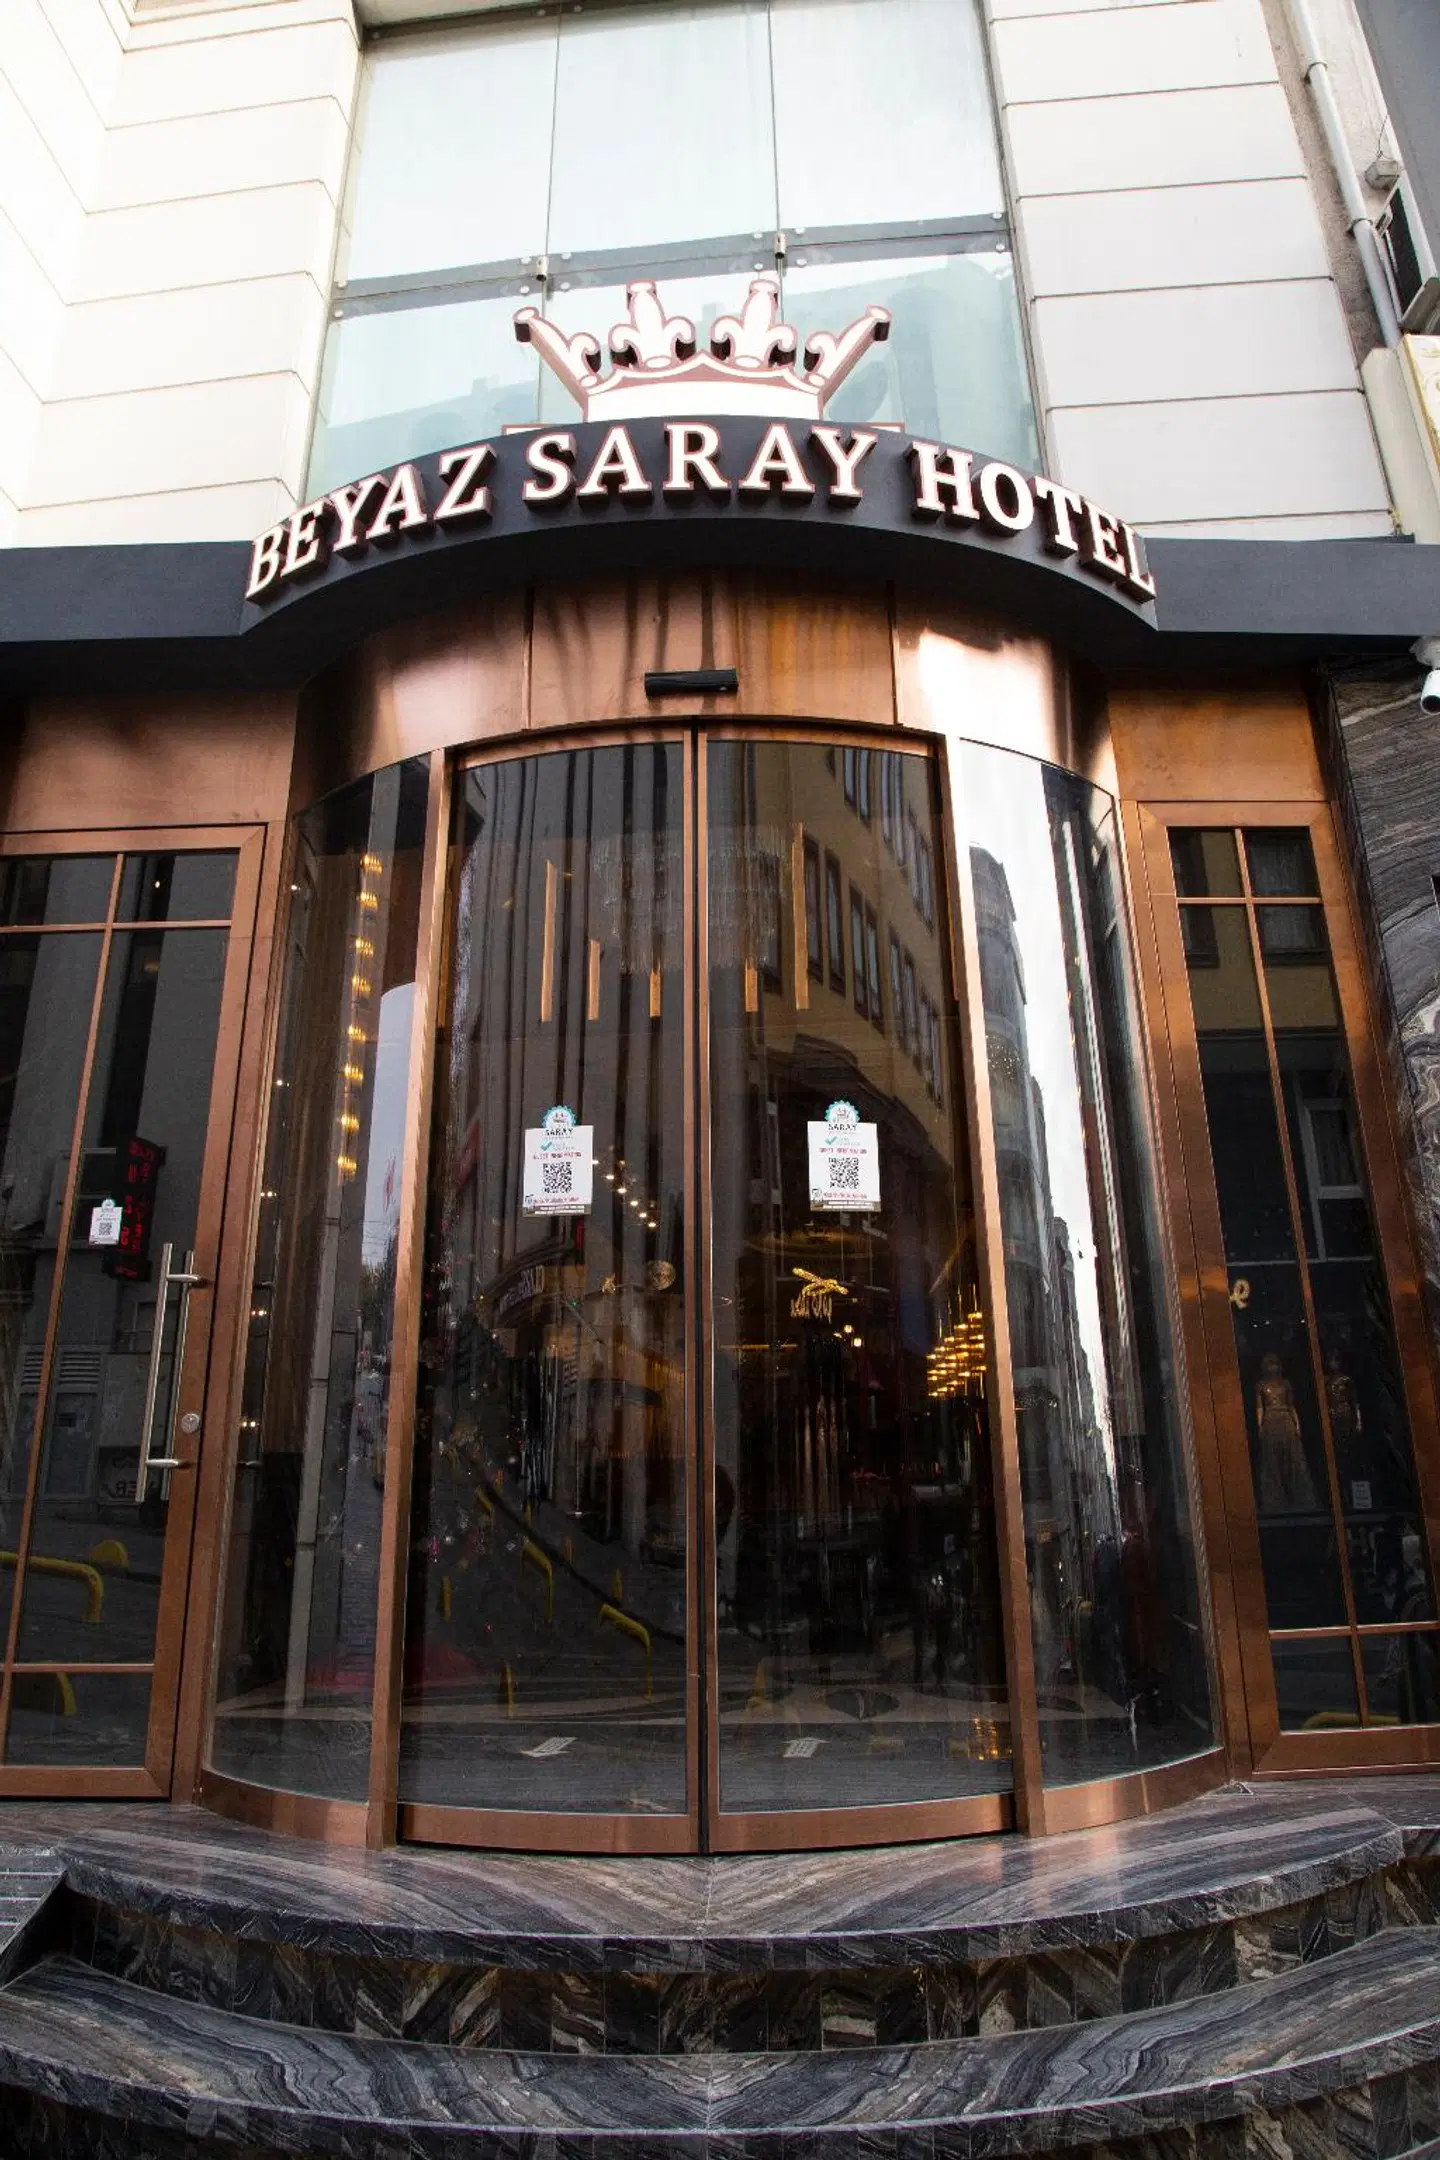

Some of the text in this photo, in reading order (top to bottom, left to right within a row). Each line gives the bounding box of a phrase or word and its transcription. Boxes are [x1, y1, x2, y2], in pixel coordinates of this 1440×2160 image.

[245, 423, 1157, 602] BEYAZ SARAY HOTEL
